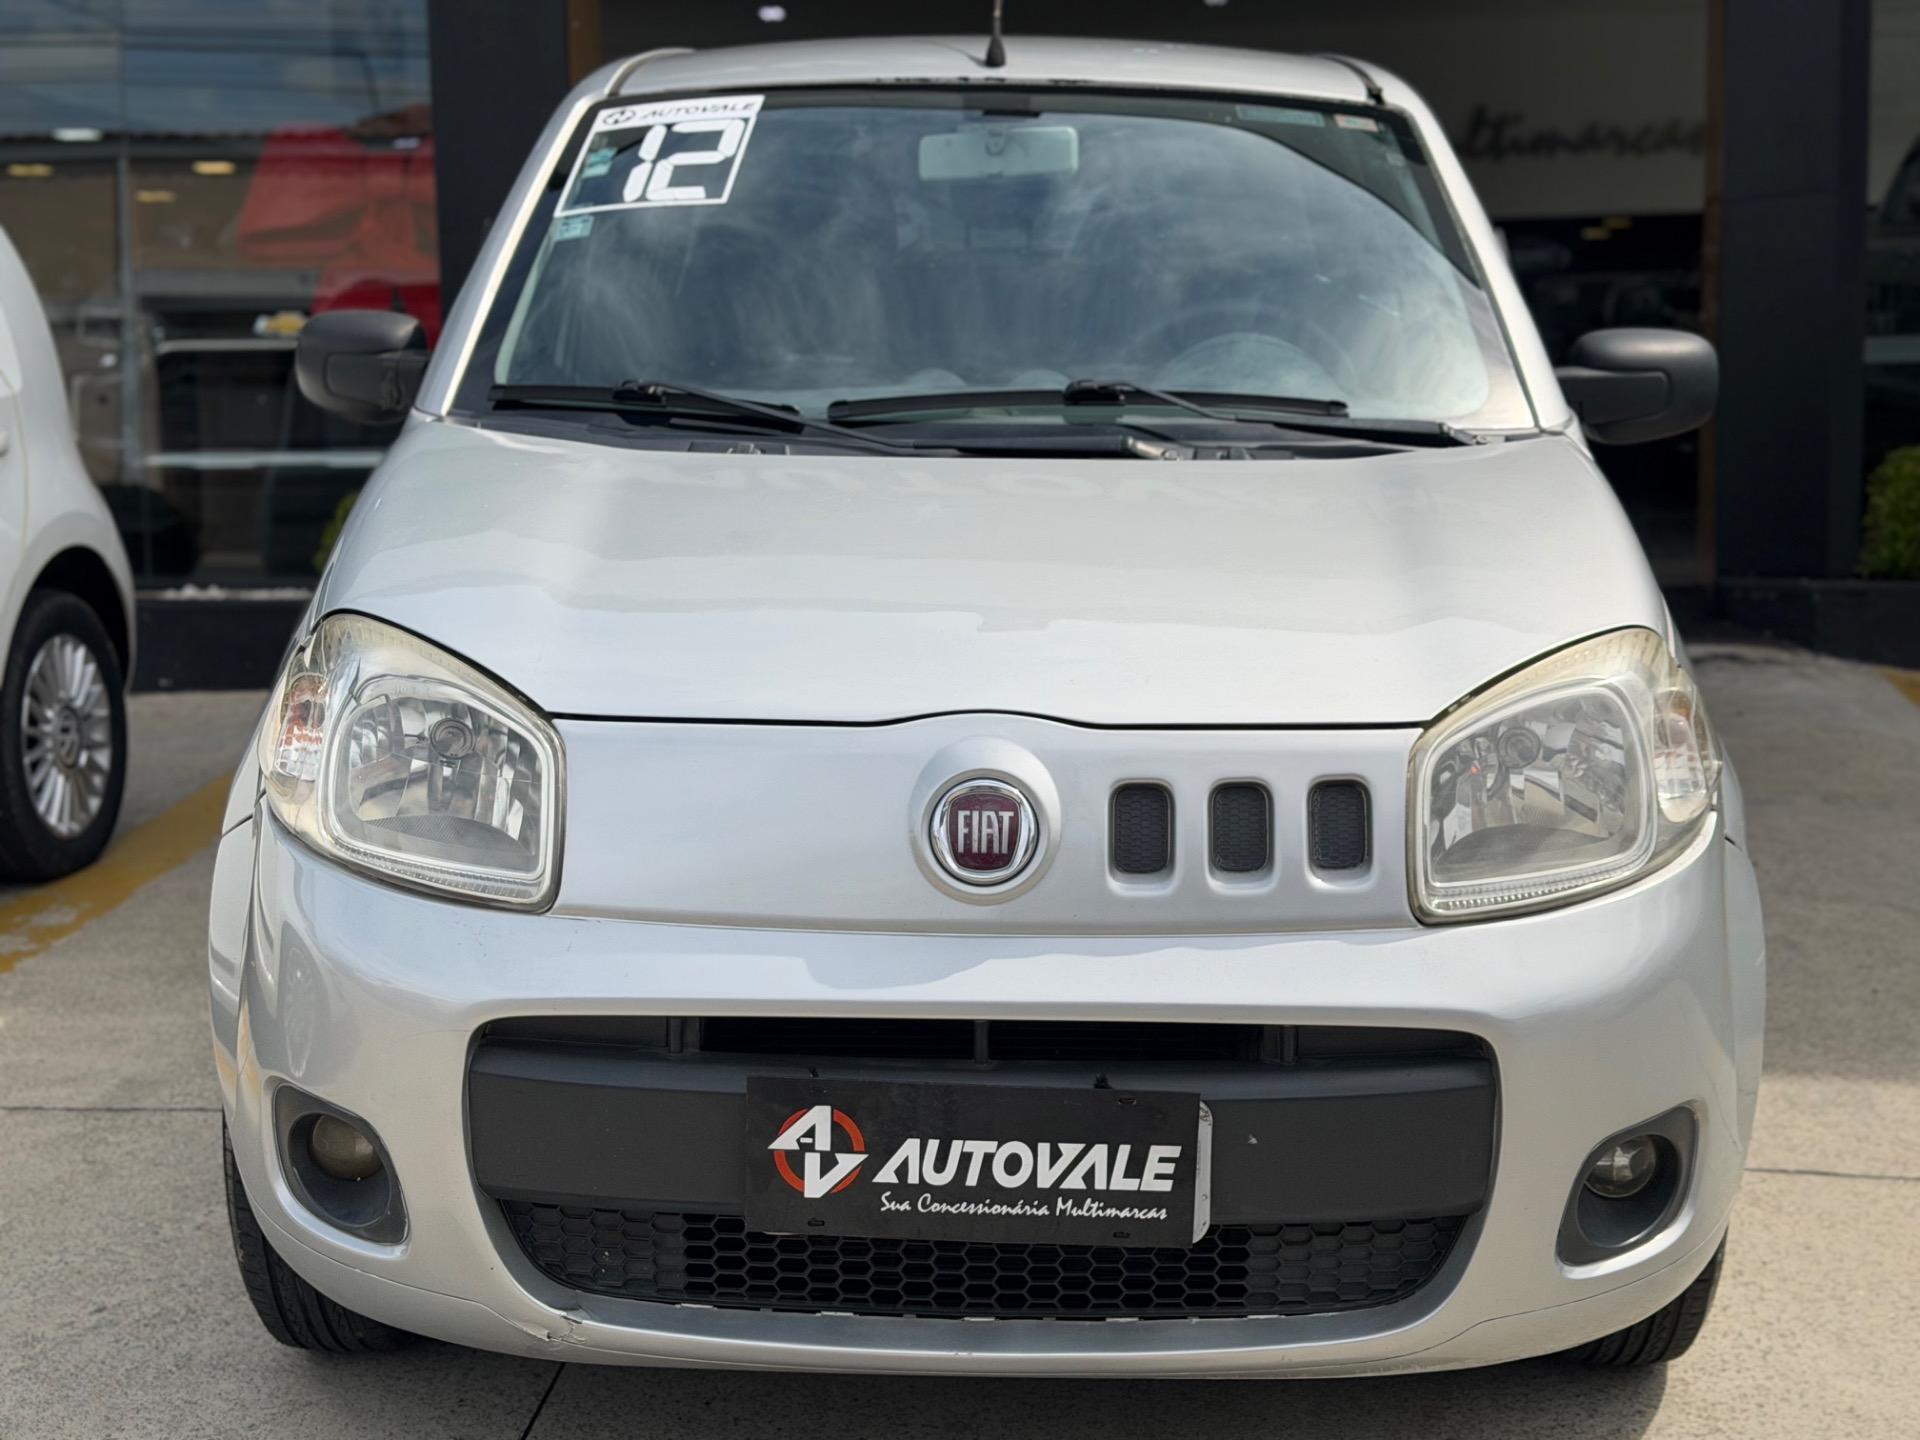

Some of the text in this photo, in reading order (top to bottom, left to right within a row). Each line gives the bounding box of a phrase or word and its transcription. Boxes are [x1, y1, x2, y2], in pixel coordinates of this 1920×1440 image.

[643, 103, 755, 118] AUTOVALE
[1455, 102, 1705, 160] ltimarcas
[623, 119, 745, 203] 12
[957, 810, 1014, 854] FIAT
[872, 1137, 1182, 1192] AUTOVALE
[880, 1191, 1168, 1221] Sua Concessionária Multimarcas
